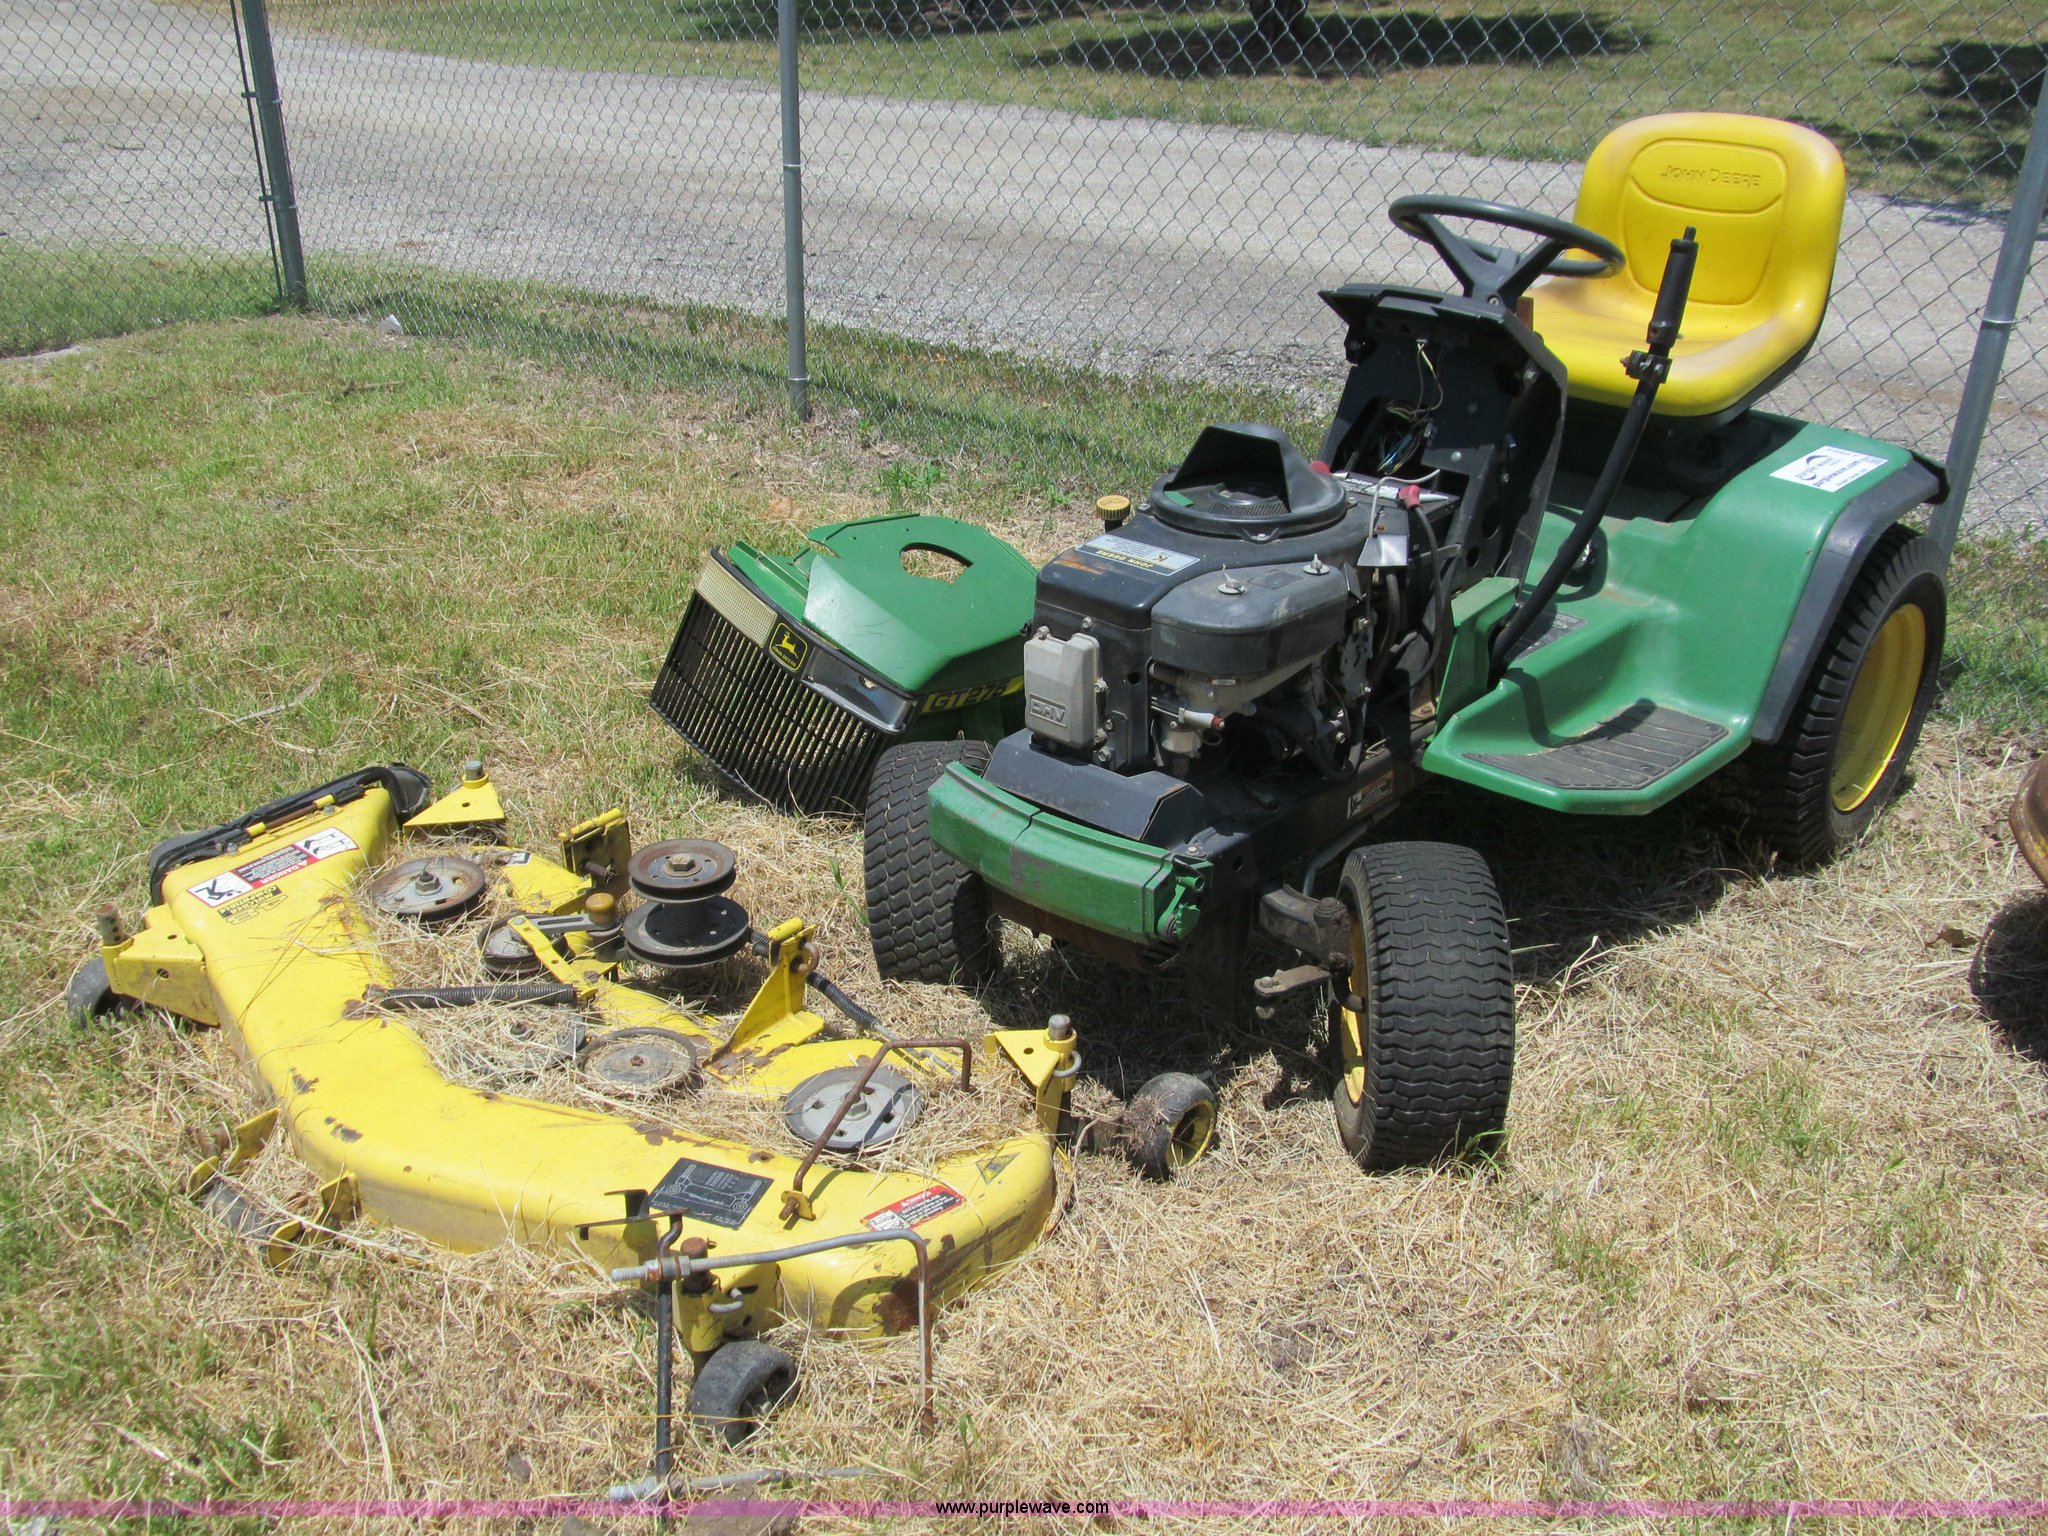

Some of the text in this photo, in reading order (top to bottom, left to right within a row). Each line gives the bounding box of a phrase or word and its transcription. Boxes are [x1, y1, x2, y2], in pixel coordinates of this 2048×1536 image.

[1660, 165, 1761, 187] JOHN DEERE
[260, 864, 300, 884] DANGER
